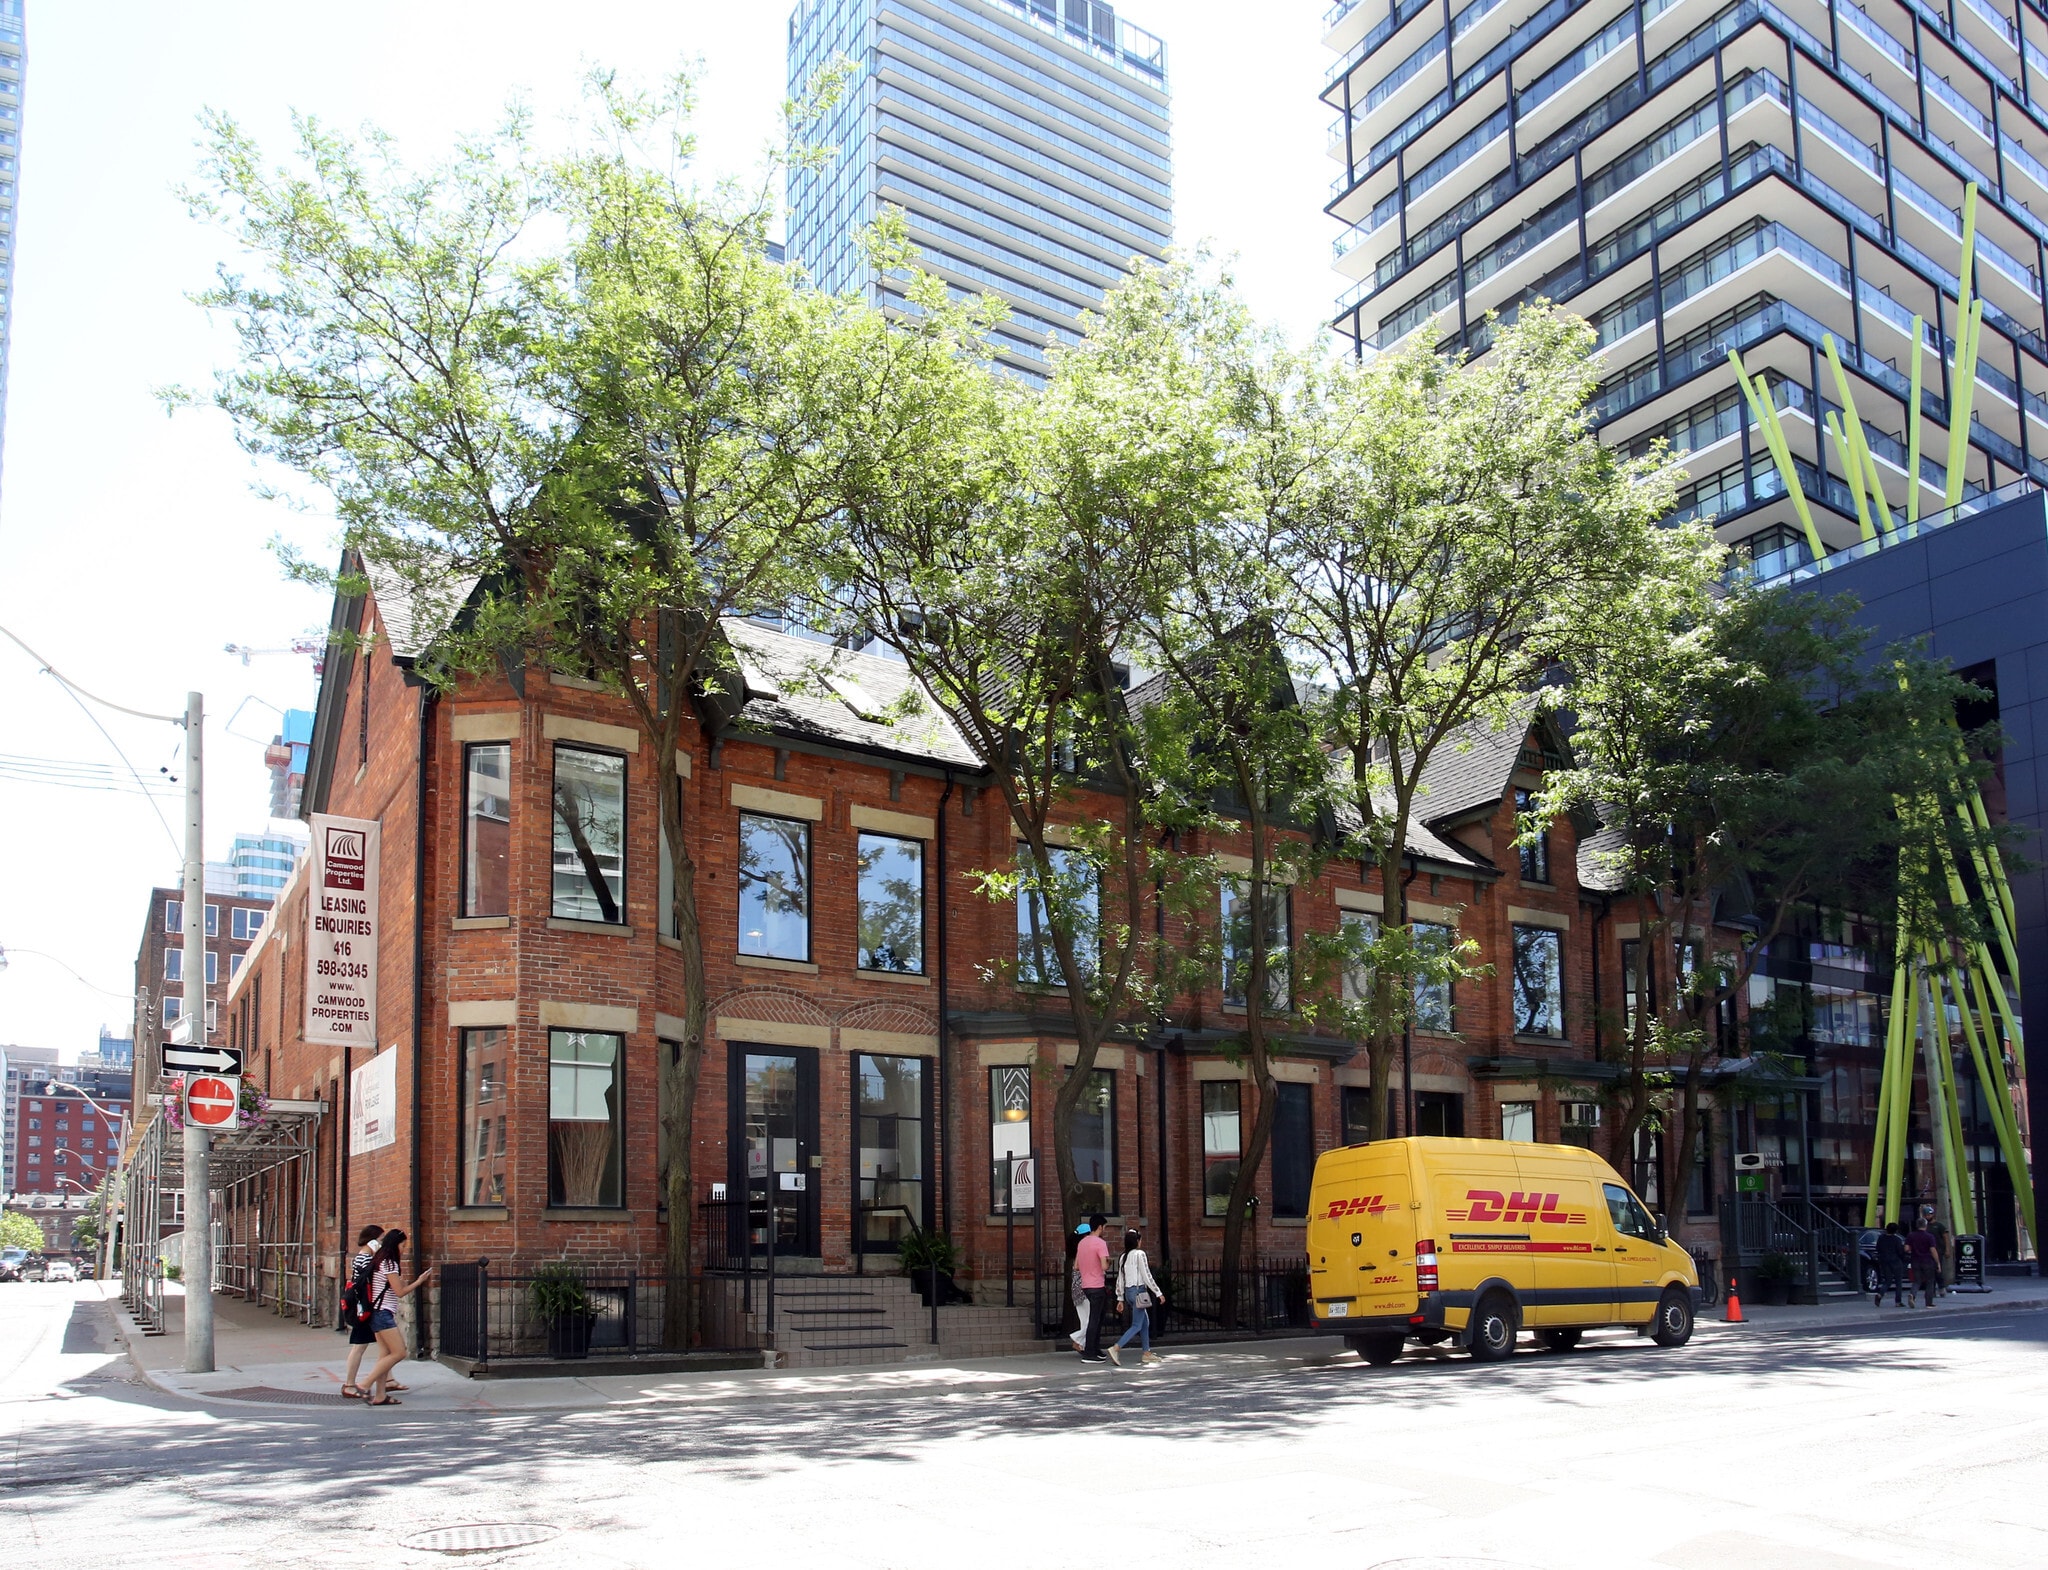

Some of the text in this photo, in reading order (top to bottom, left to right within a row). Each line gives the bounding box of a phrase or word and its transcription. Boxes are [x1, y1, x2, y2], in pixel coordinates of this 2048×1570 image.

[327, 860, 364, 871] Camwood
[325, 868, 364, 879] Properties
[337, 877, 352, 885] Ltd.
[321, 896, 366, 914] LEASING
[315, 916, 372, 936] ENQUIRIES
[333, 940, 352, 956] 416
[317, 960, 368, 979] 598-3345
[317, 994, 366, 1008] CAMWOOD
[312, 1008, 370, 1021] PROPERTIES
[329, 1022, 353, 1033] .COM
[1327, 1195, 1387, 1219] DHL
[1467, 1190, 1569, 1224] DHL
[1373, 1275, 1398, 1284] DHL
